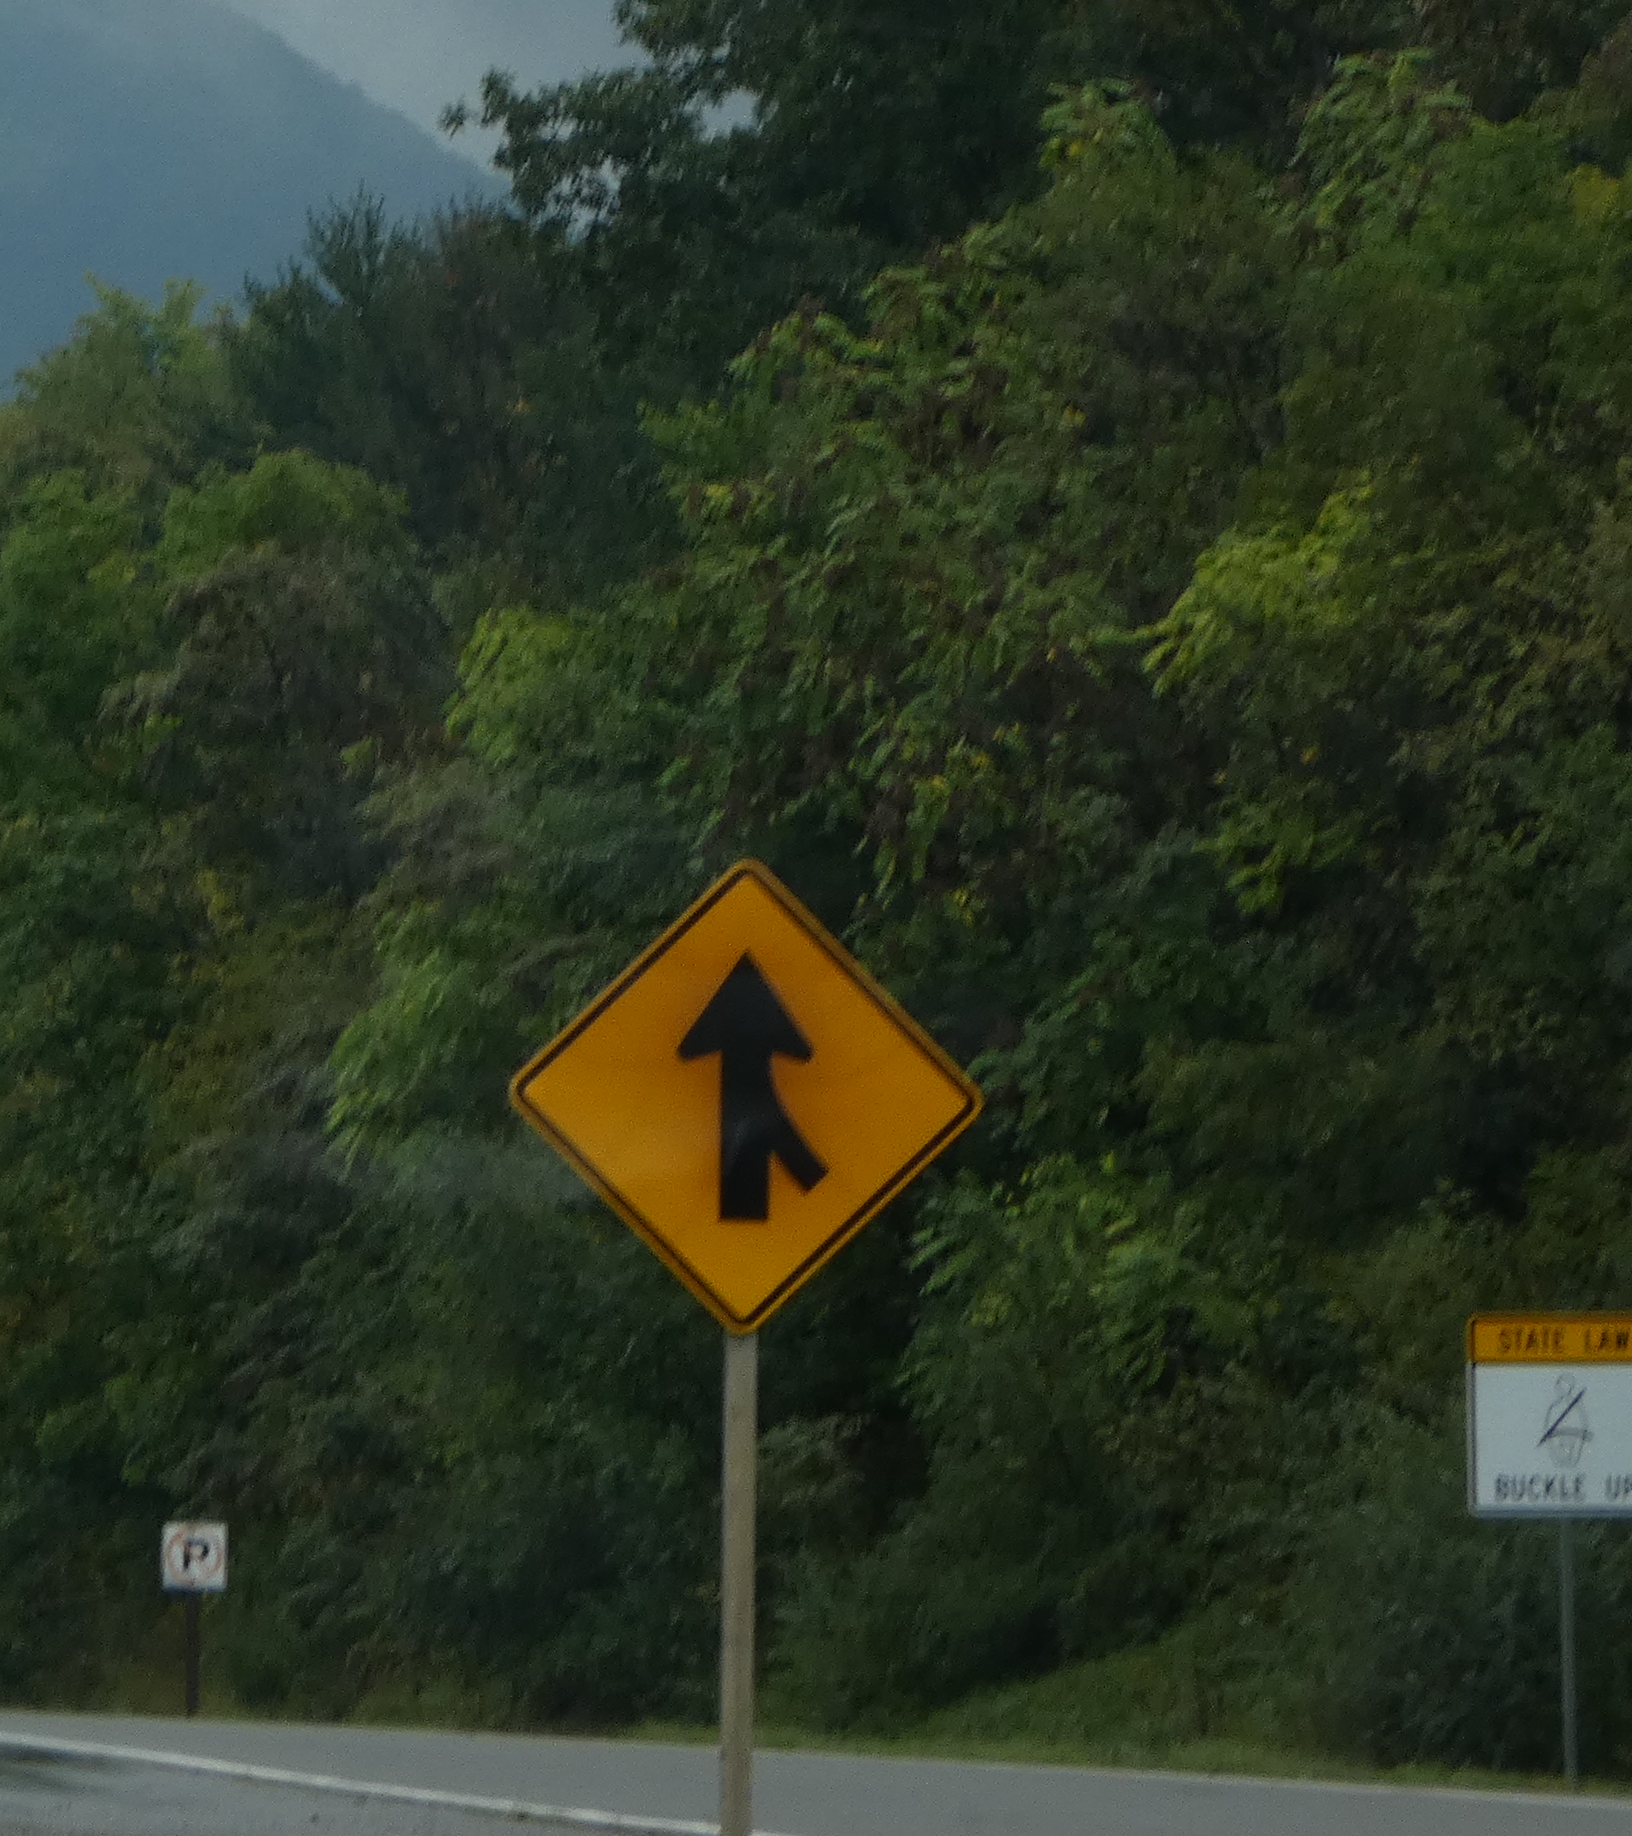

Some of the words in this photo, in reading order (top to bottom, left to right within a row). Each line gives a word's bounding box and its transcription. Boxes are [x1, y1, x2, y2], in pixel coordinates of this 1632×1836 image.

[1499, 1328, 1565, 1354] STATE
[1585, 1328, 1631, 1353] LAW
[1494, 1473, 1585, 1502] BUCKLE
[183, 1536, 210, 1571] P
